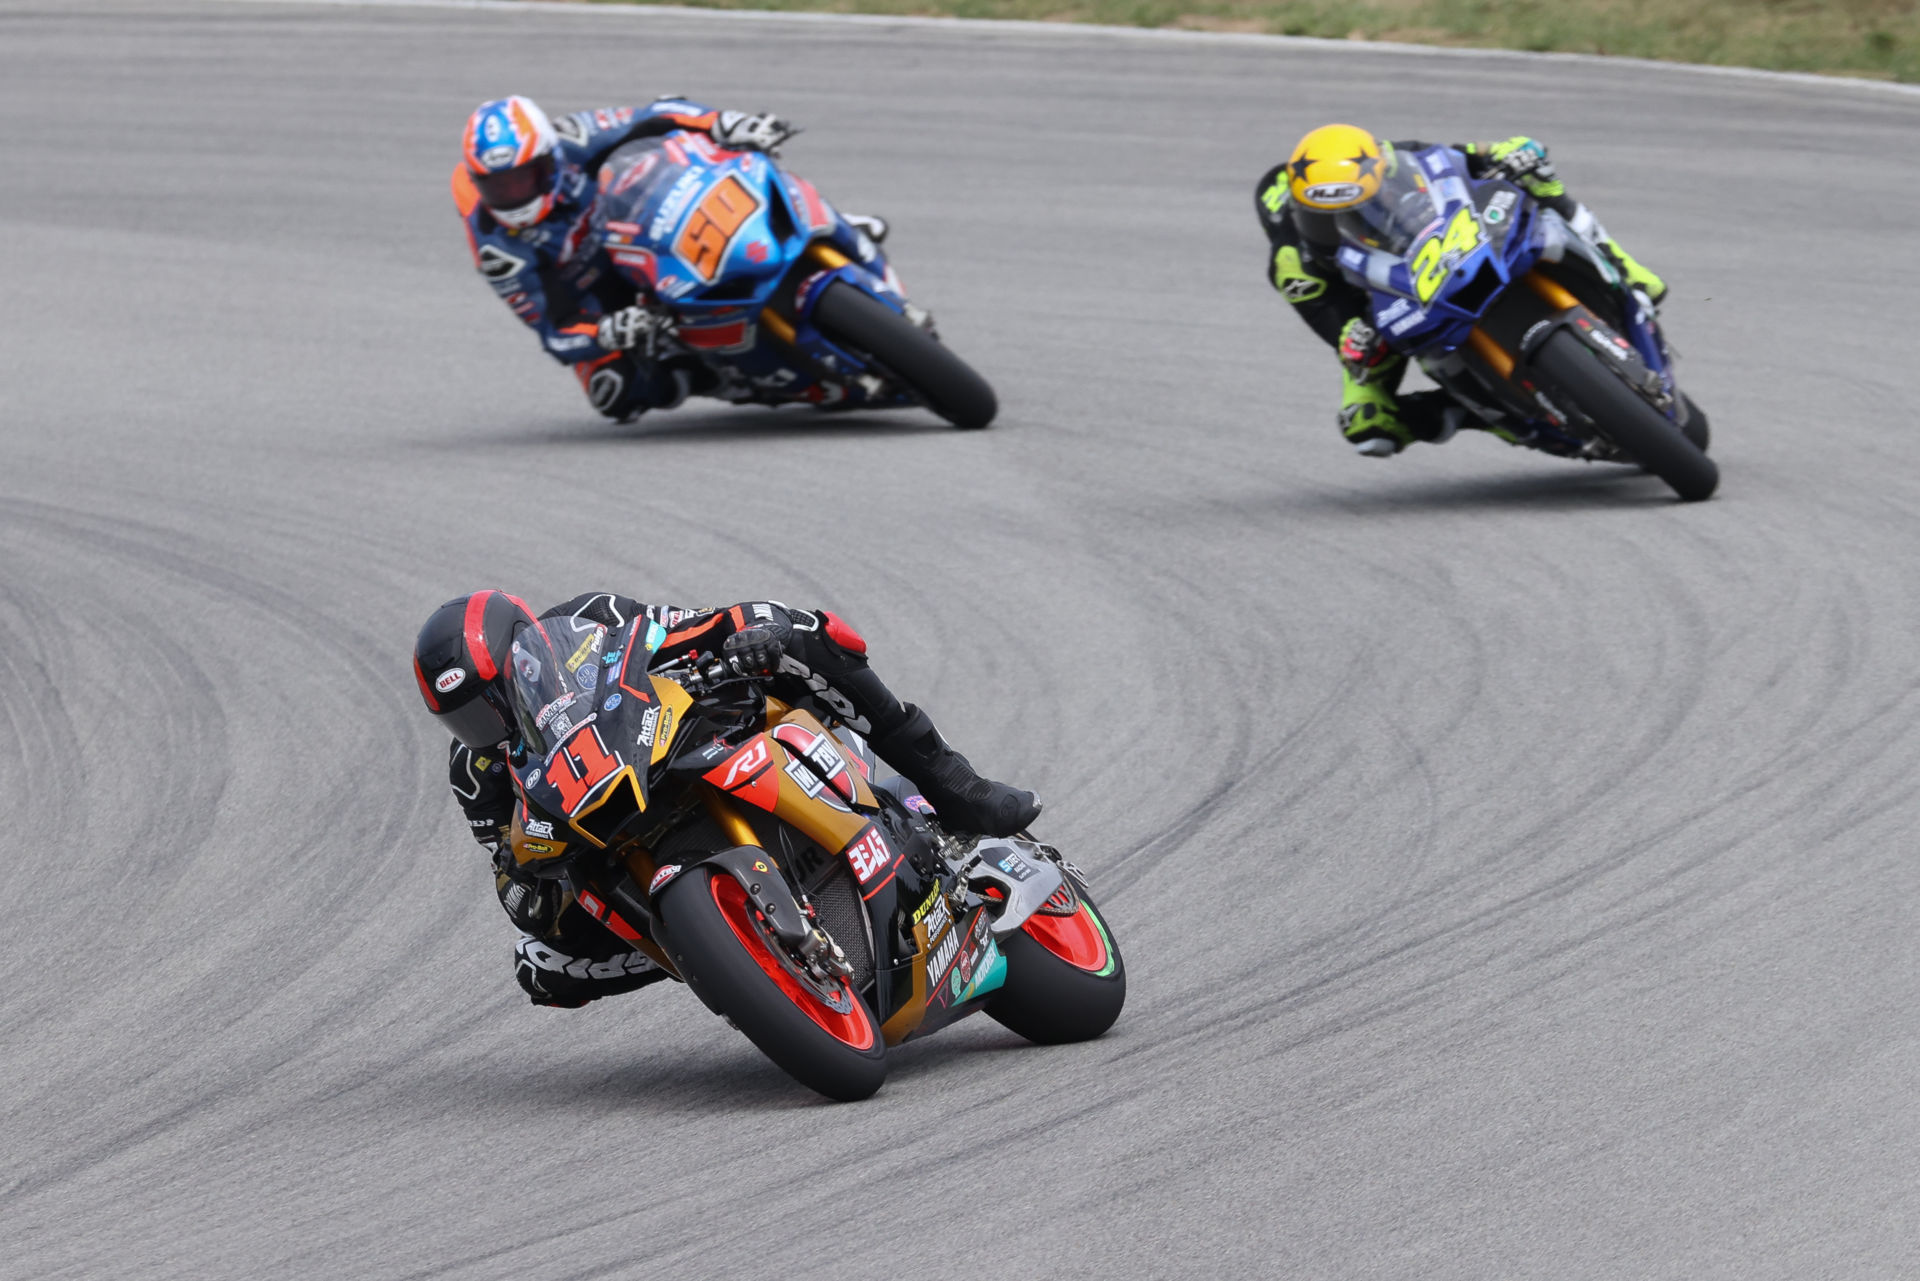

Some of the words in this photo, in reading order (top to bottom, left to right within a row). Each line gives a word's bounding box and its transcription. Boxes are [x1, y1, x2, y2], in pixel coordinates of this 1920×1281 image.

[1311, 184, 1355, 199] HJC
[675, 174, 761, 281] 50
[1412, 207, 1481, 304] 24
[439, 672, 461, 688] BELL
[545, 727, 618, 814] 11
[723, 740, 767, 787] R1
[526, 819, 554, 840] Attack
[927, 927, 960, 986] YAMAHA
